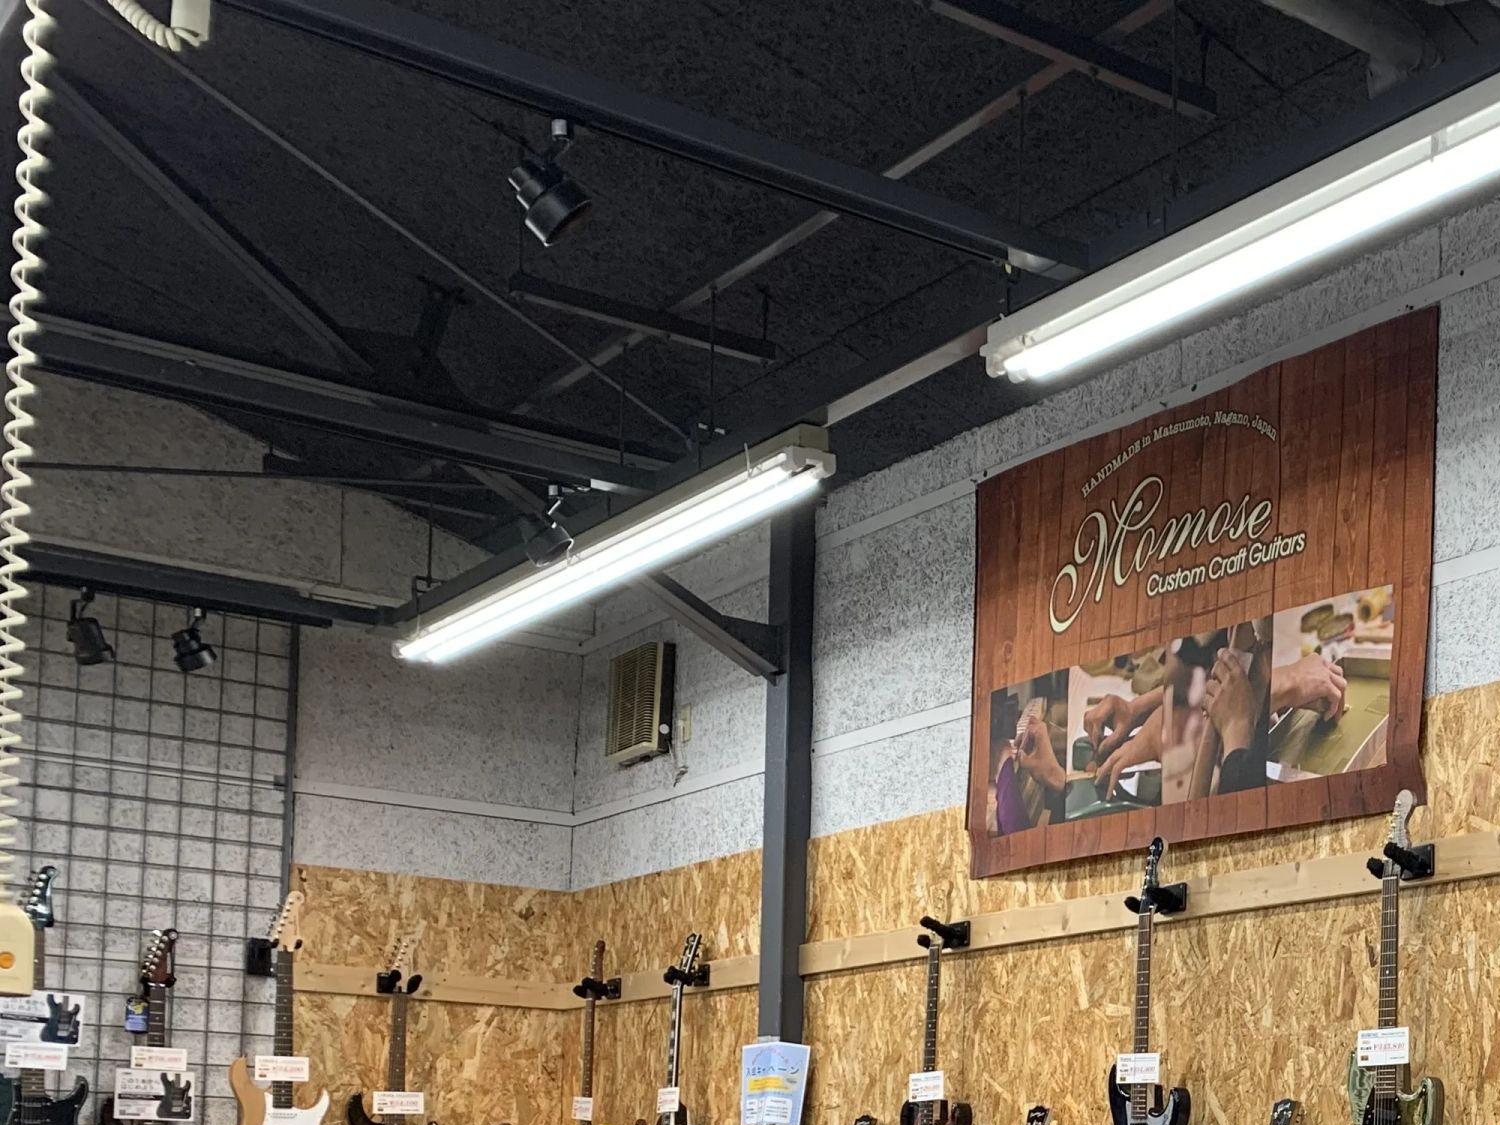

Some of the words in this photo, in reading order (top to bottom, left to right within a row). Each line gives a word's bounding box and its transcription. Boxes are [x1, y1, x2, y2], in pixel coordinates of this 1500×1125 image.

[1081, 440, 1141, 498] HANDMADE
[1142, 435, 1152, 449] in
[1153, 418, 1213, 442] Matsumoto,
[1214, 410, 1251, 428] Nagano,
[1252, 415, 1278, 442] Japan
[1050, 476, 1272, 633] Momose
[1146, 566, 1206, 597] Custom
[1208, 551, 1248, 580] Craft
[1249, 532, 1306, 567] Guitars
